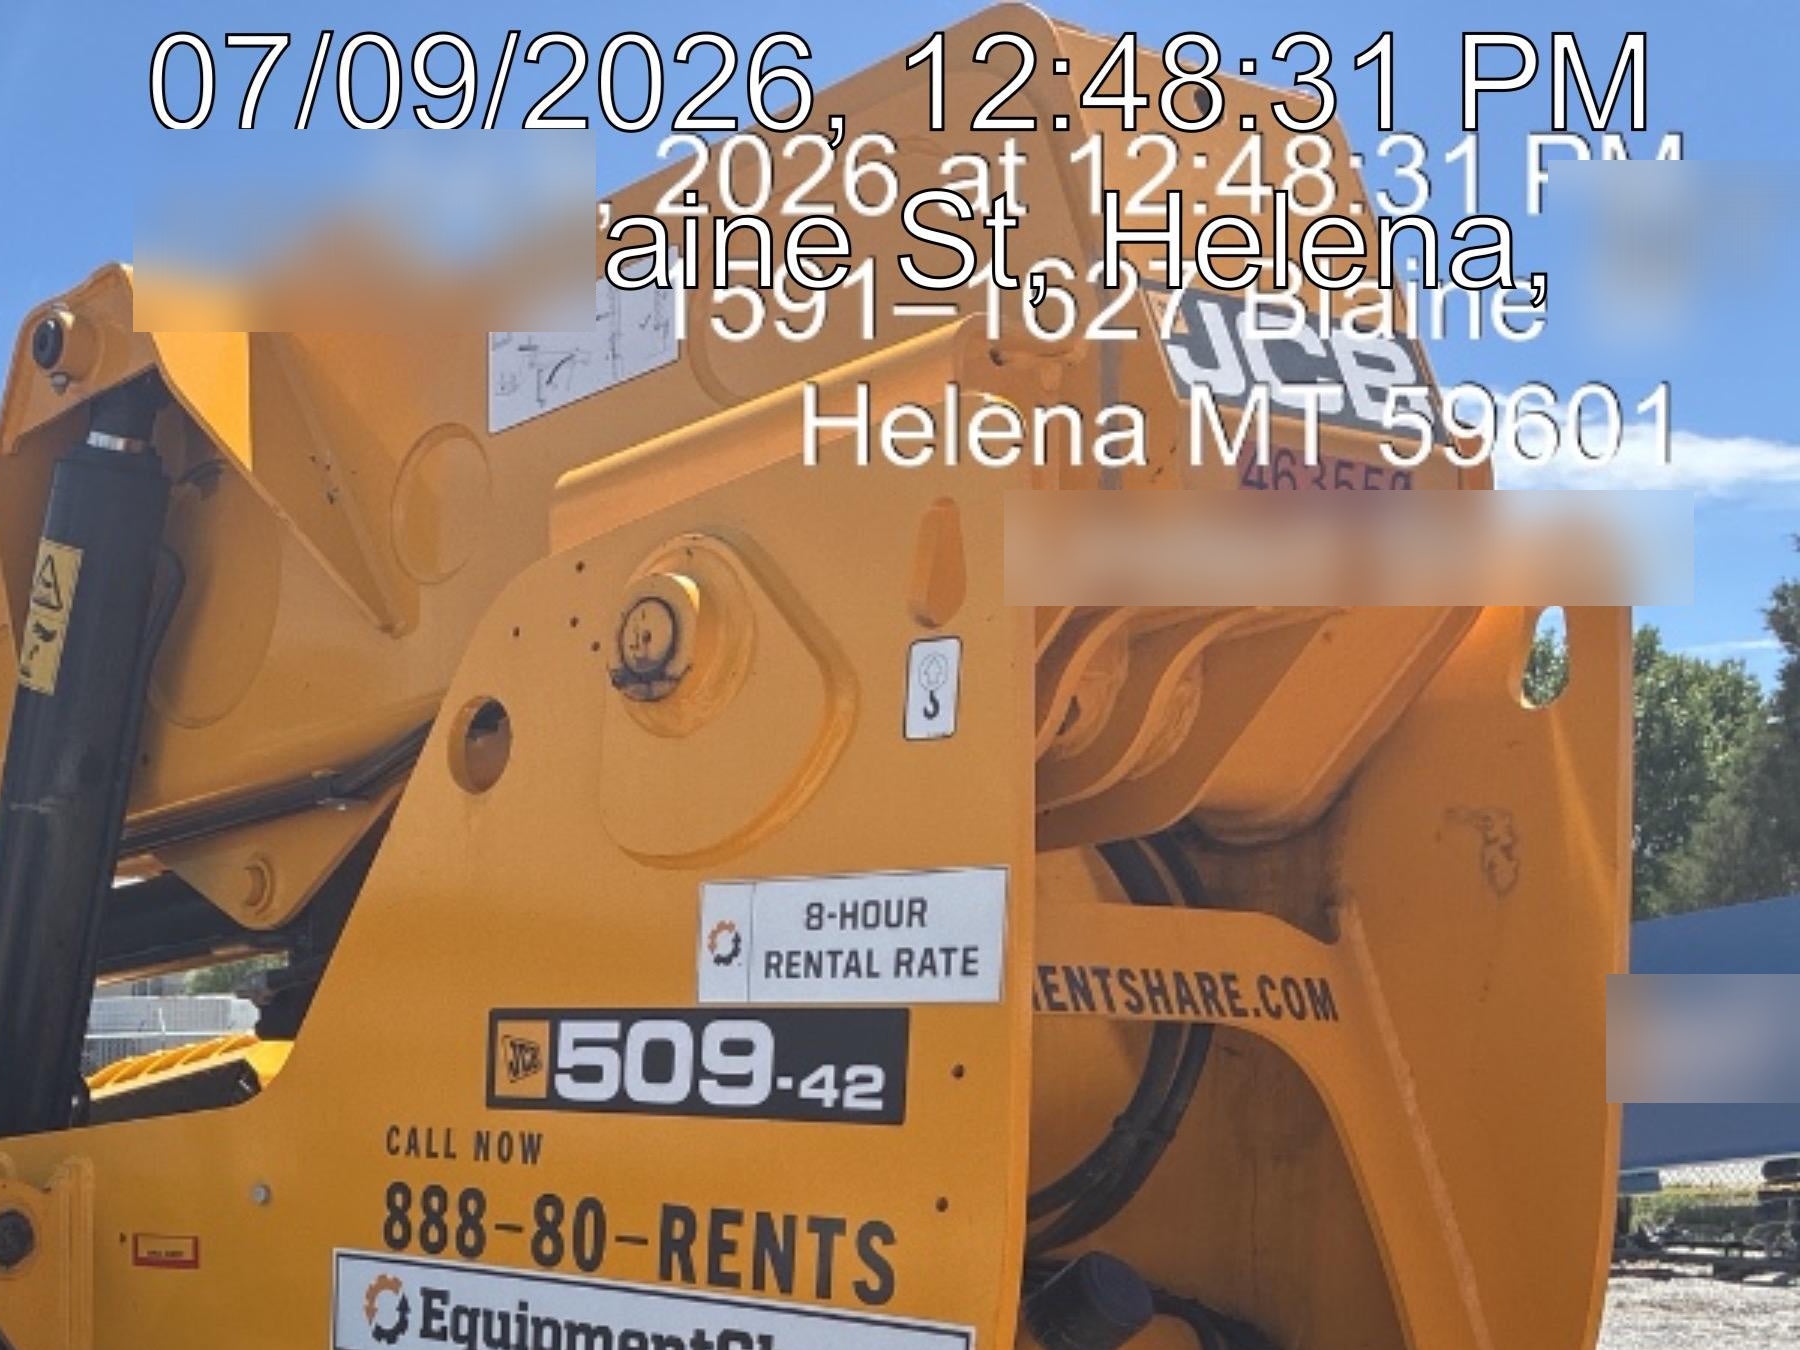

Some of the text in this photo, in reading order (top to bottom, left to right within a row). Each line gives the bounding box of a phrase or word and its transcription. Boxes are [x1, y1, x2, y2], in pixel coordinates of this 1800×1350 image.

[1166, 298, 1436, 425] JCB
[805, 896, 928, 931] 8-HOUR
[763, 945, 979, 979] RENTAL RATE
[1033, 964, 1339, 1022] ENTSHARE.COM
[554, 1018, 886, 1111] 509-42
[386, 1124, 543, 1165] CALL NOW
[383, 1181, 898, 1306] 888-80-RENTS
